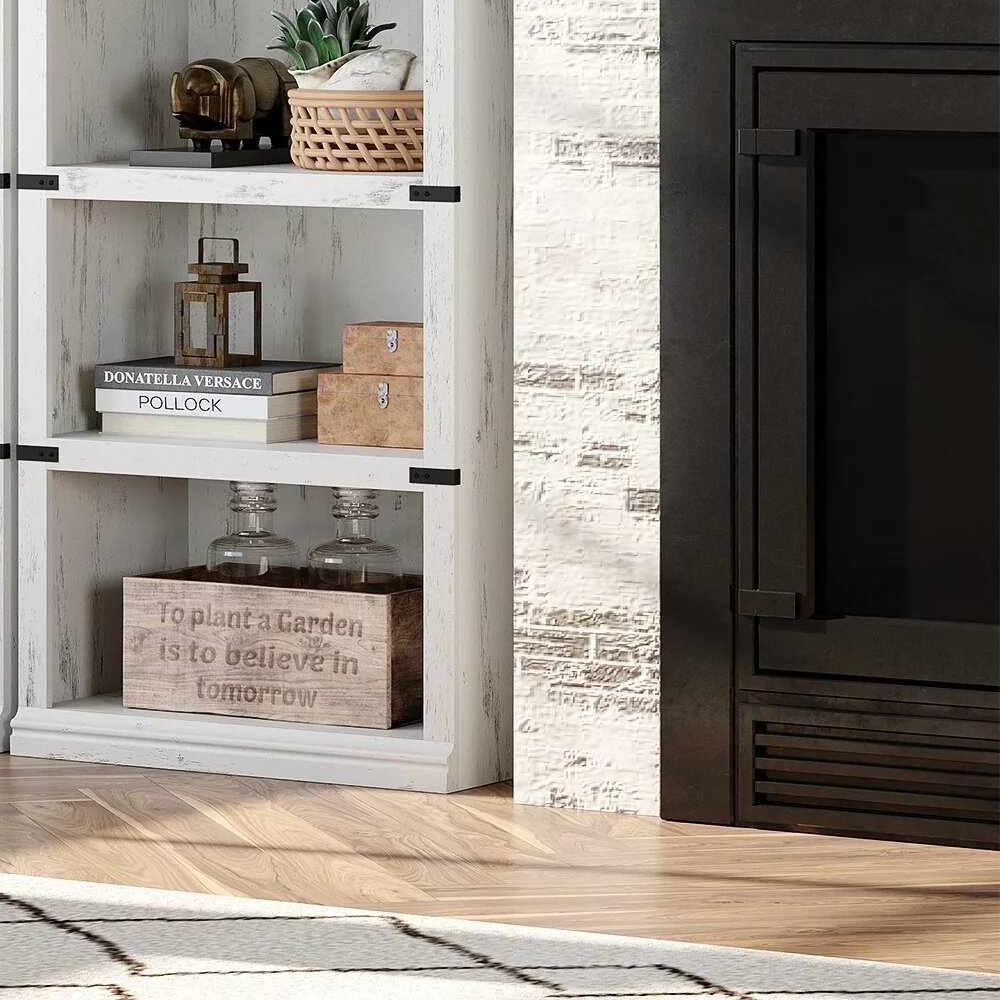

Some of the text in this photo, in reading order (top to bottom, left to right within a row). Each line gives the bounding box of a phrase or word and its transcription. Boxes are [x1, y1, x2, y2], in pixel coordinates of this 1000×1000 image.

[104, 370, 262, 390] DONATELLA VERSACE
[139, 395, 222, 412] POLLOCK
[157, 601, 363, 638] To plant a Garden
[160, 637, 359, 675] is to believe in
[196, 677, 318, 708] tomorrow
